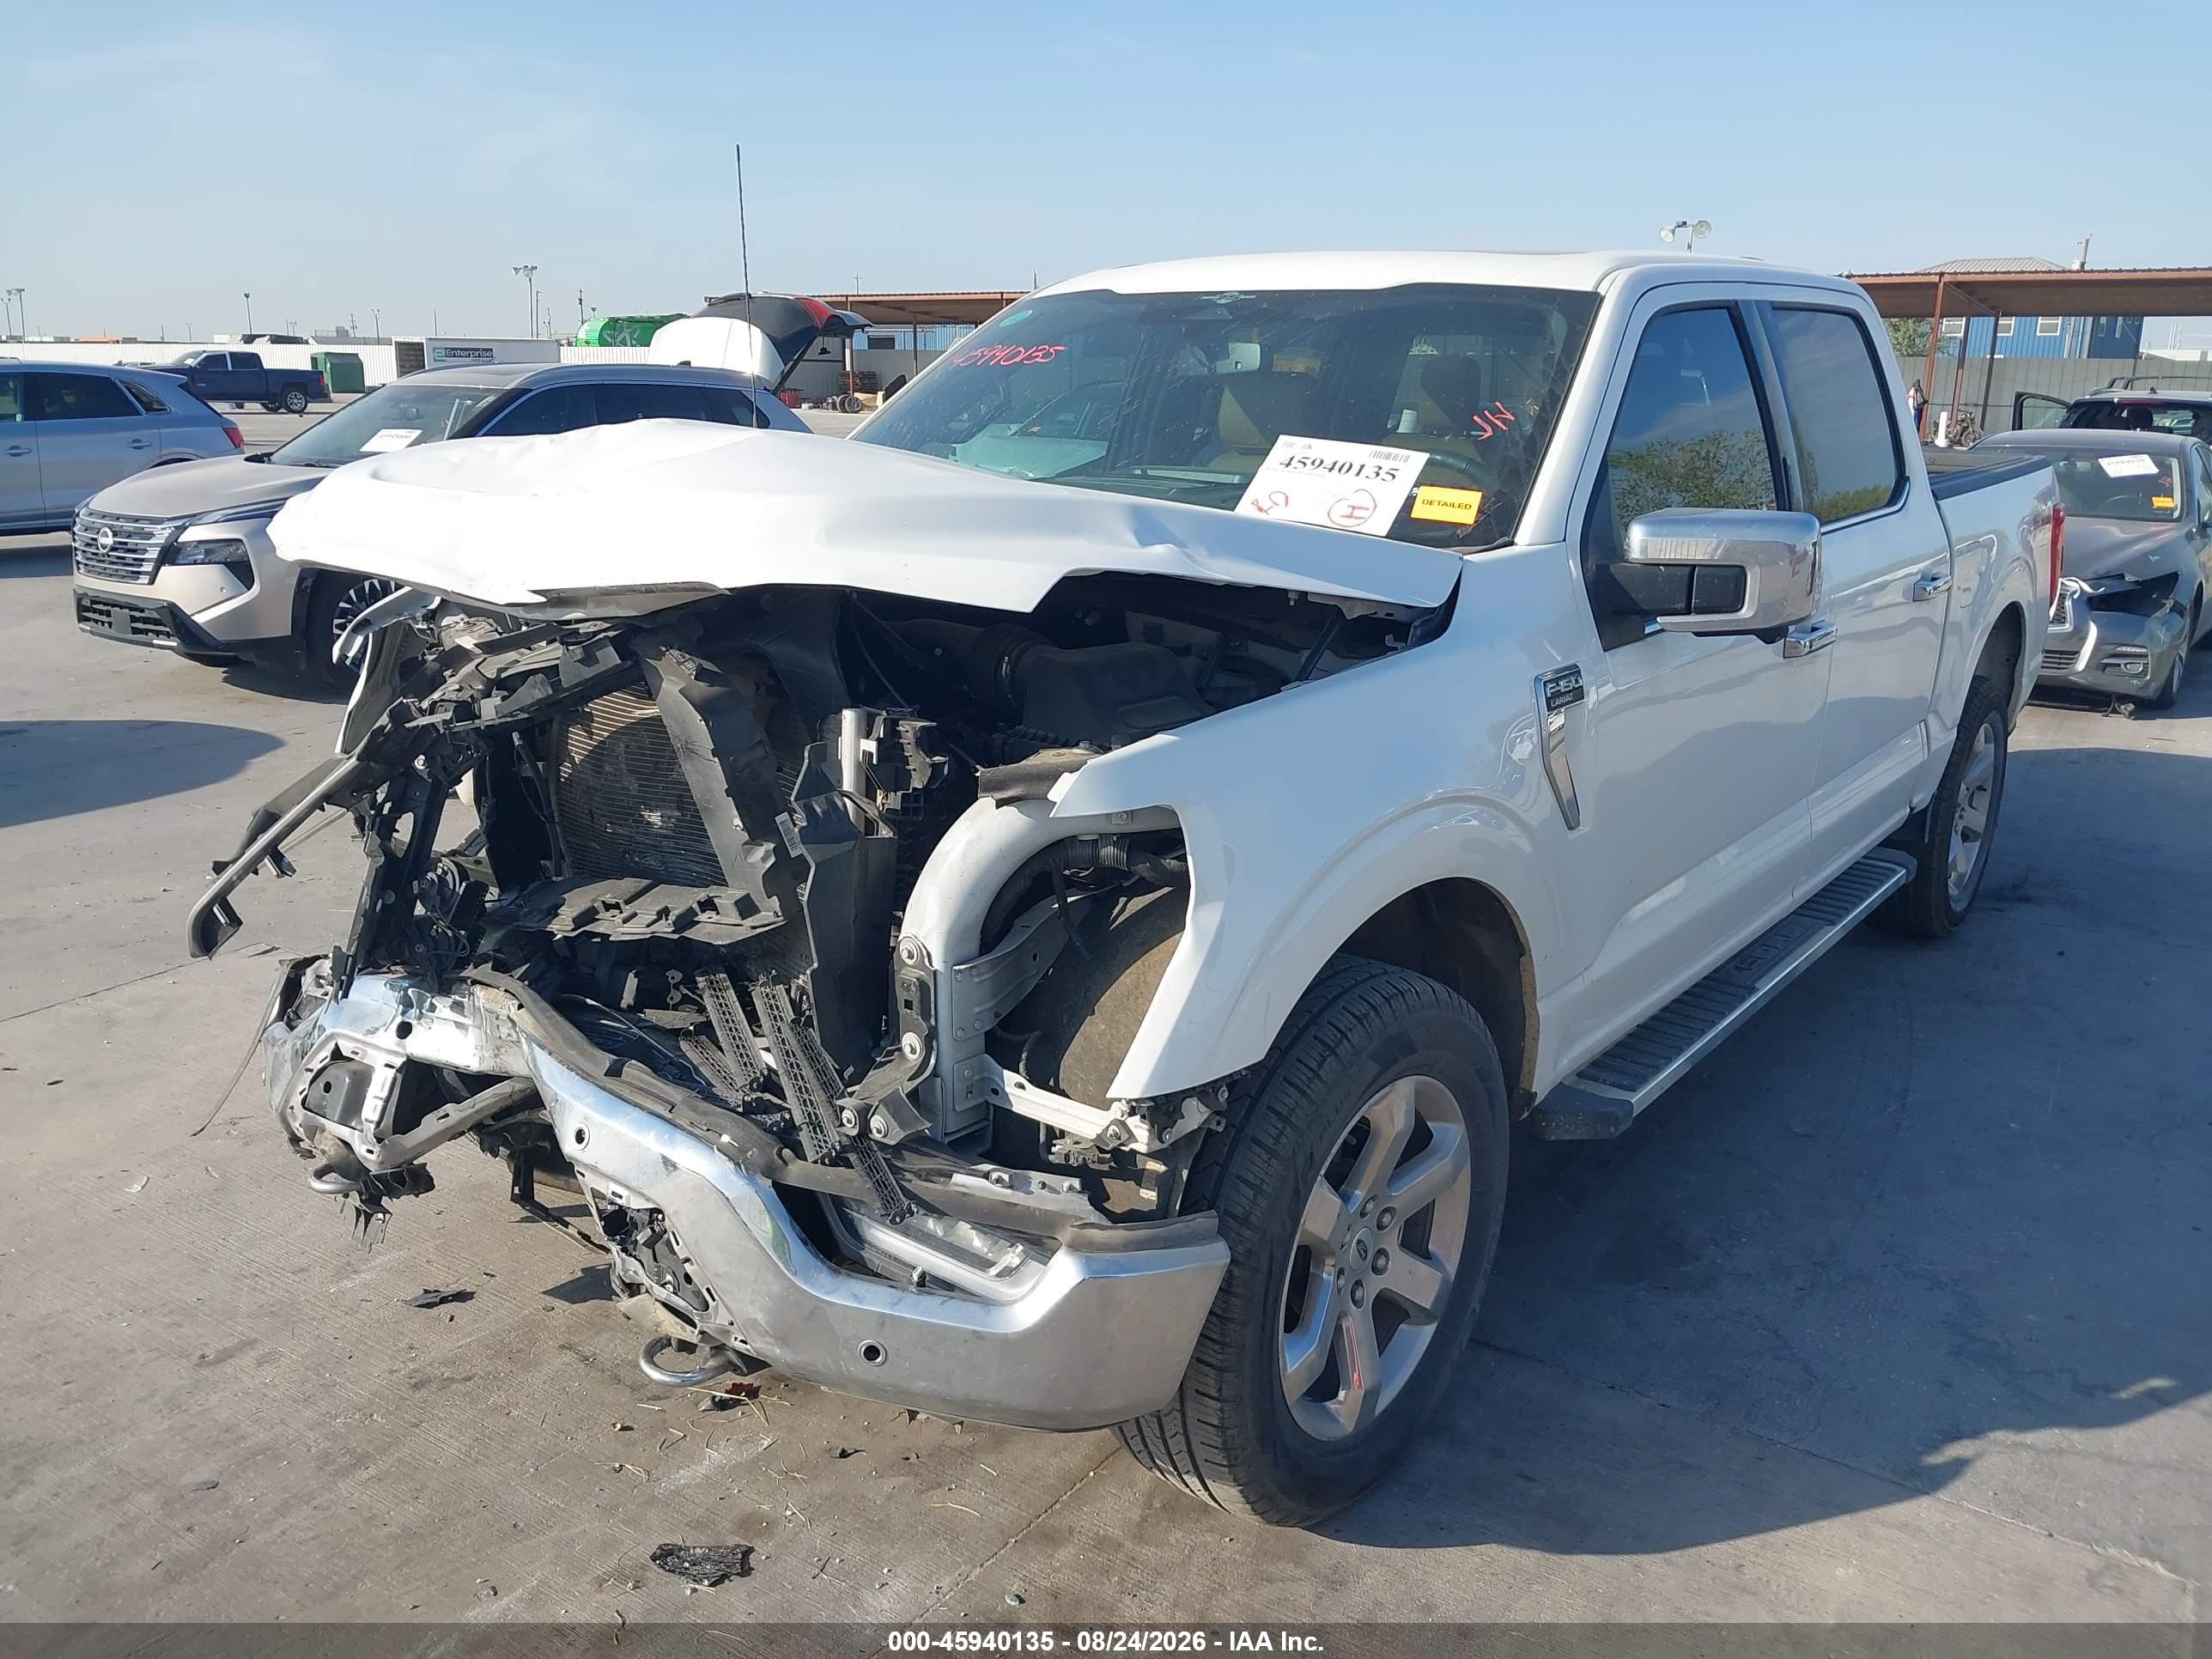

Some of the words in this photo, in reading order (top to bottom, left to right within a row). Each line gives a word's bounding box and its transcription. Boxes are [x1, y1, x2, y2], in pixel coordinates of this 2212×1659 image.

[446, 349, 493, 359] Enterprise
[1279, 454, 1401, 483] 45940135
[1421, 498, 1473, 510] DETAILED
[1546, 676, 1583, 697] F-150
[1551, 693, 1574, 708] LARIAT
